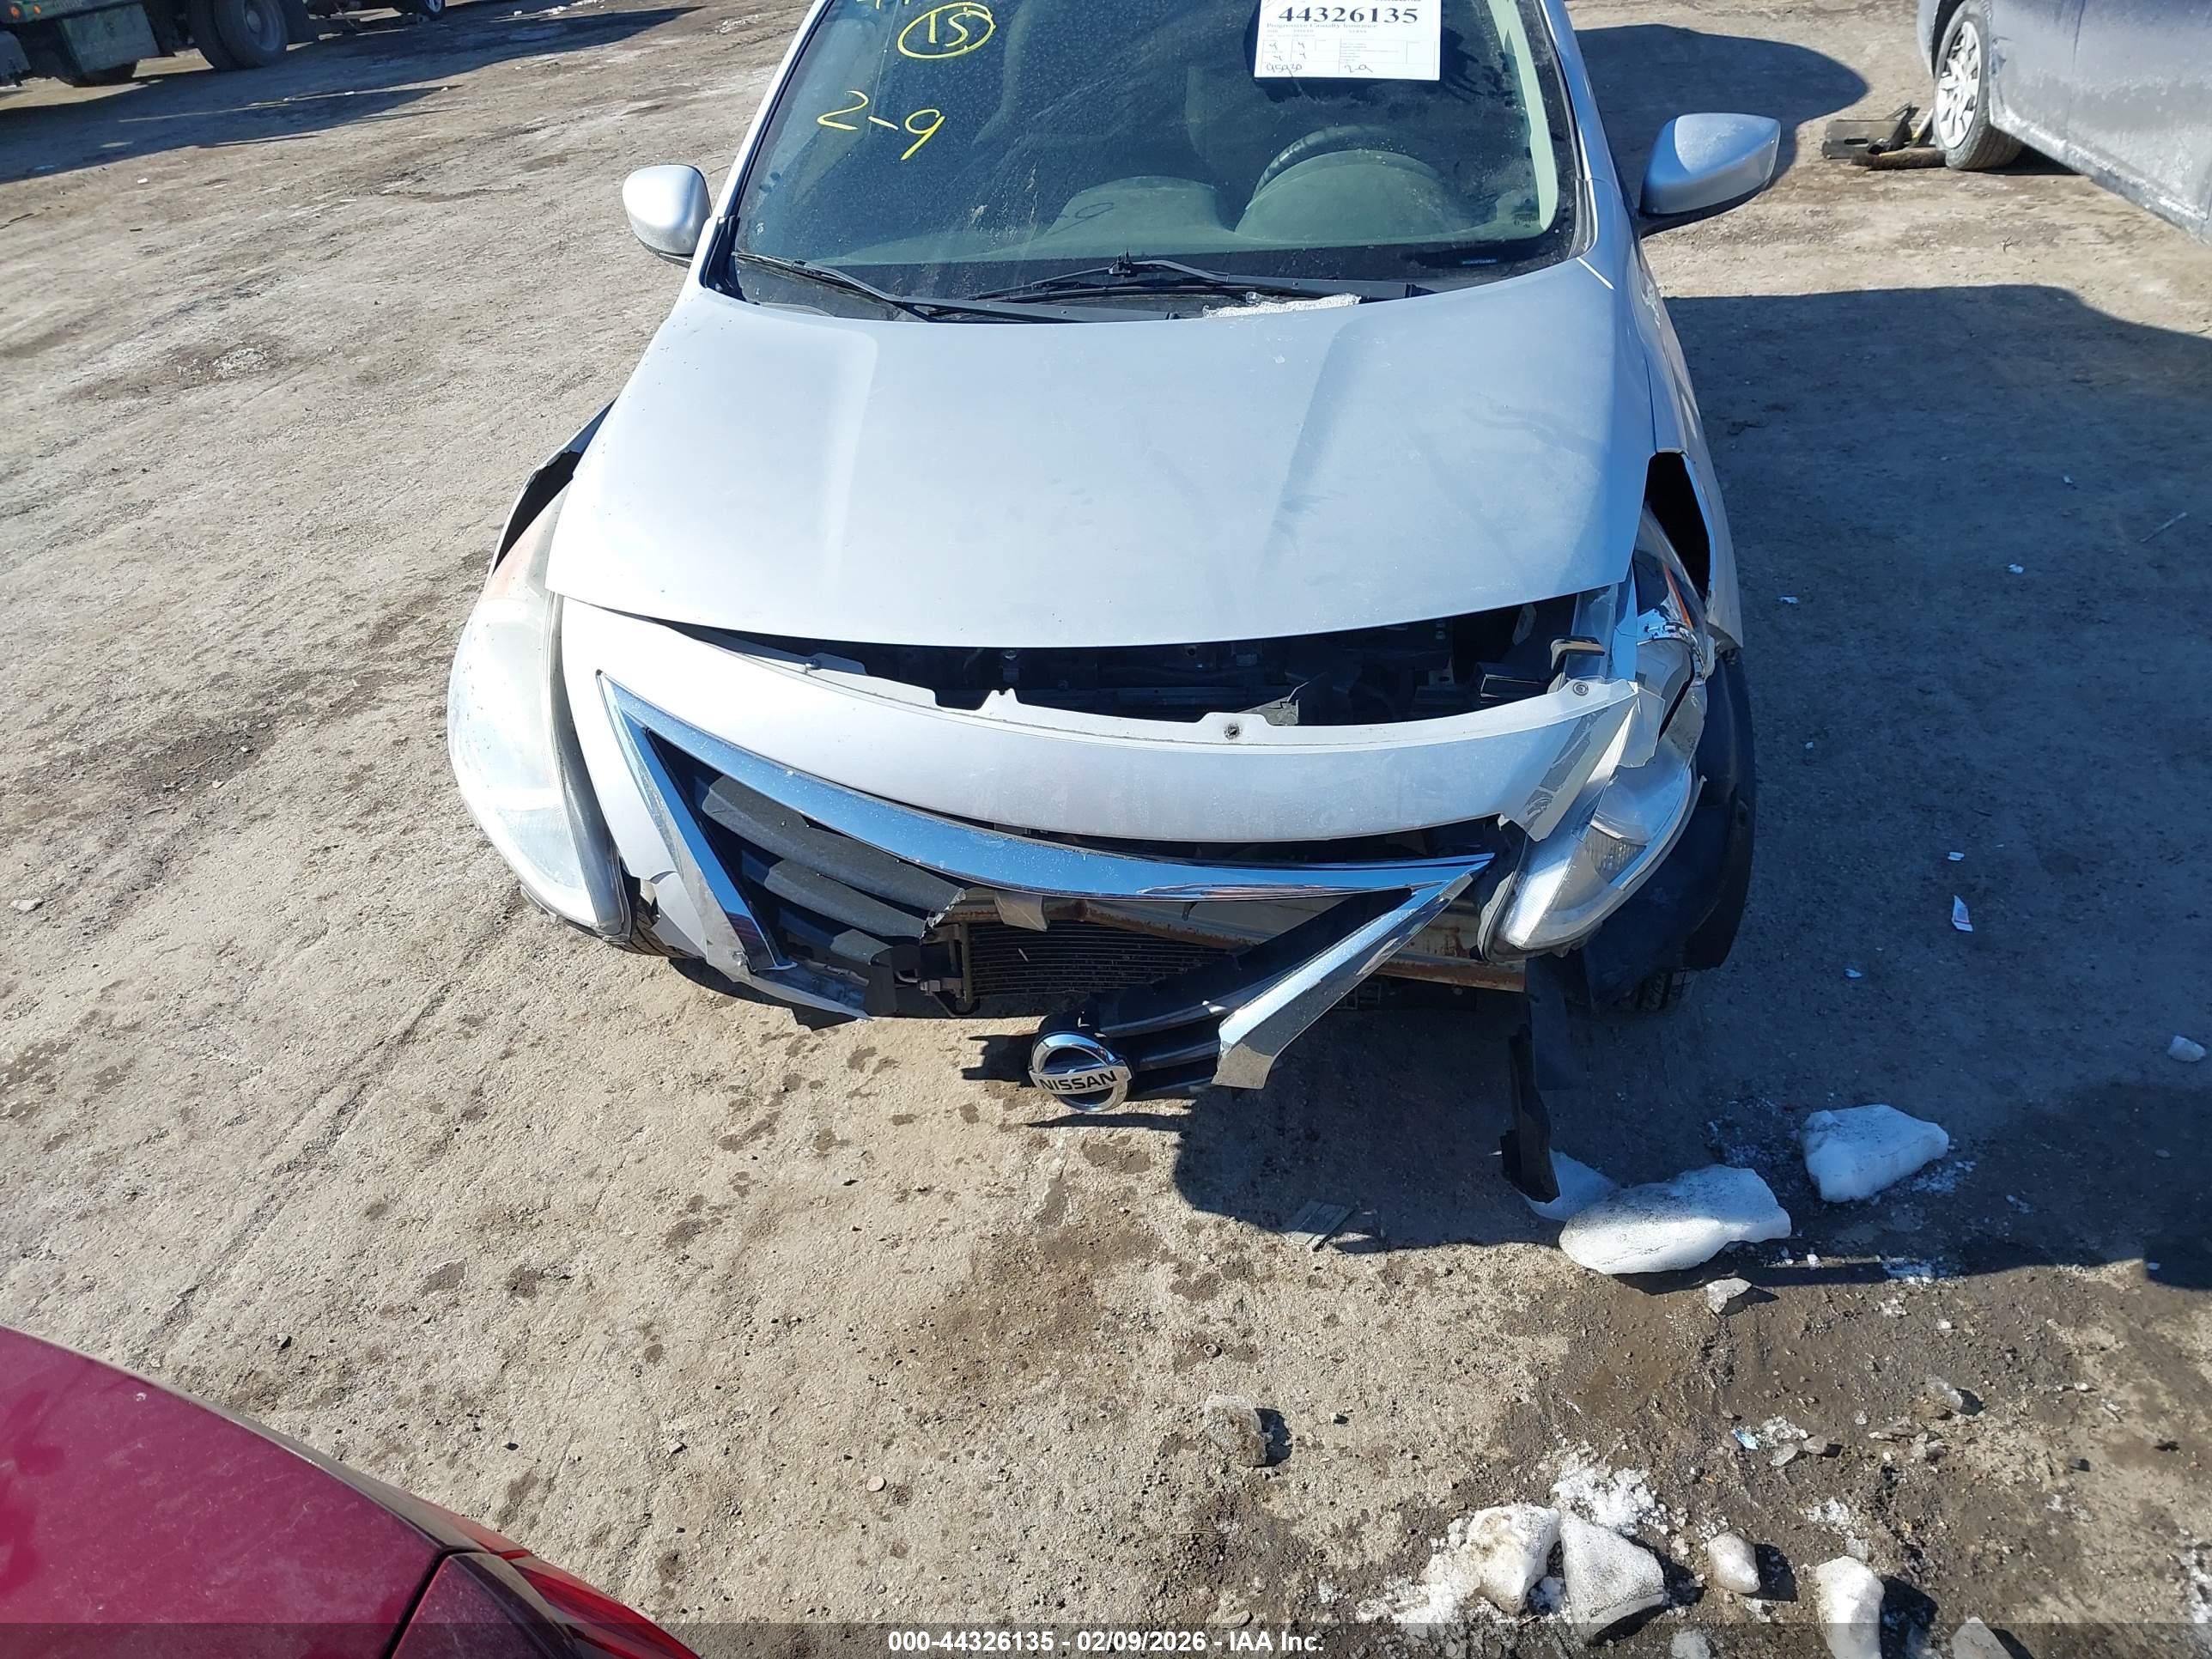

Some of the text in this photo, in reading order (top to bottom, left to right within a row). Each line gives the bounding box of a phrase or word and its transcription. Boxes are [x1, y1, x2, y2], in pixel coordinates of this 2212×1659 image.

[1278, 6, 1419, 24] 44326135
[817, 89, 945, 161] 2-9
[1038, 1070, 1118, 1091] NISSAN
